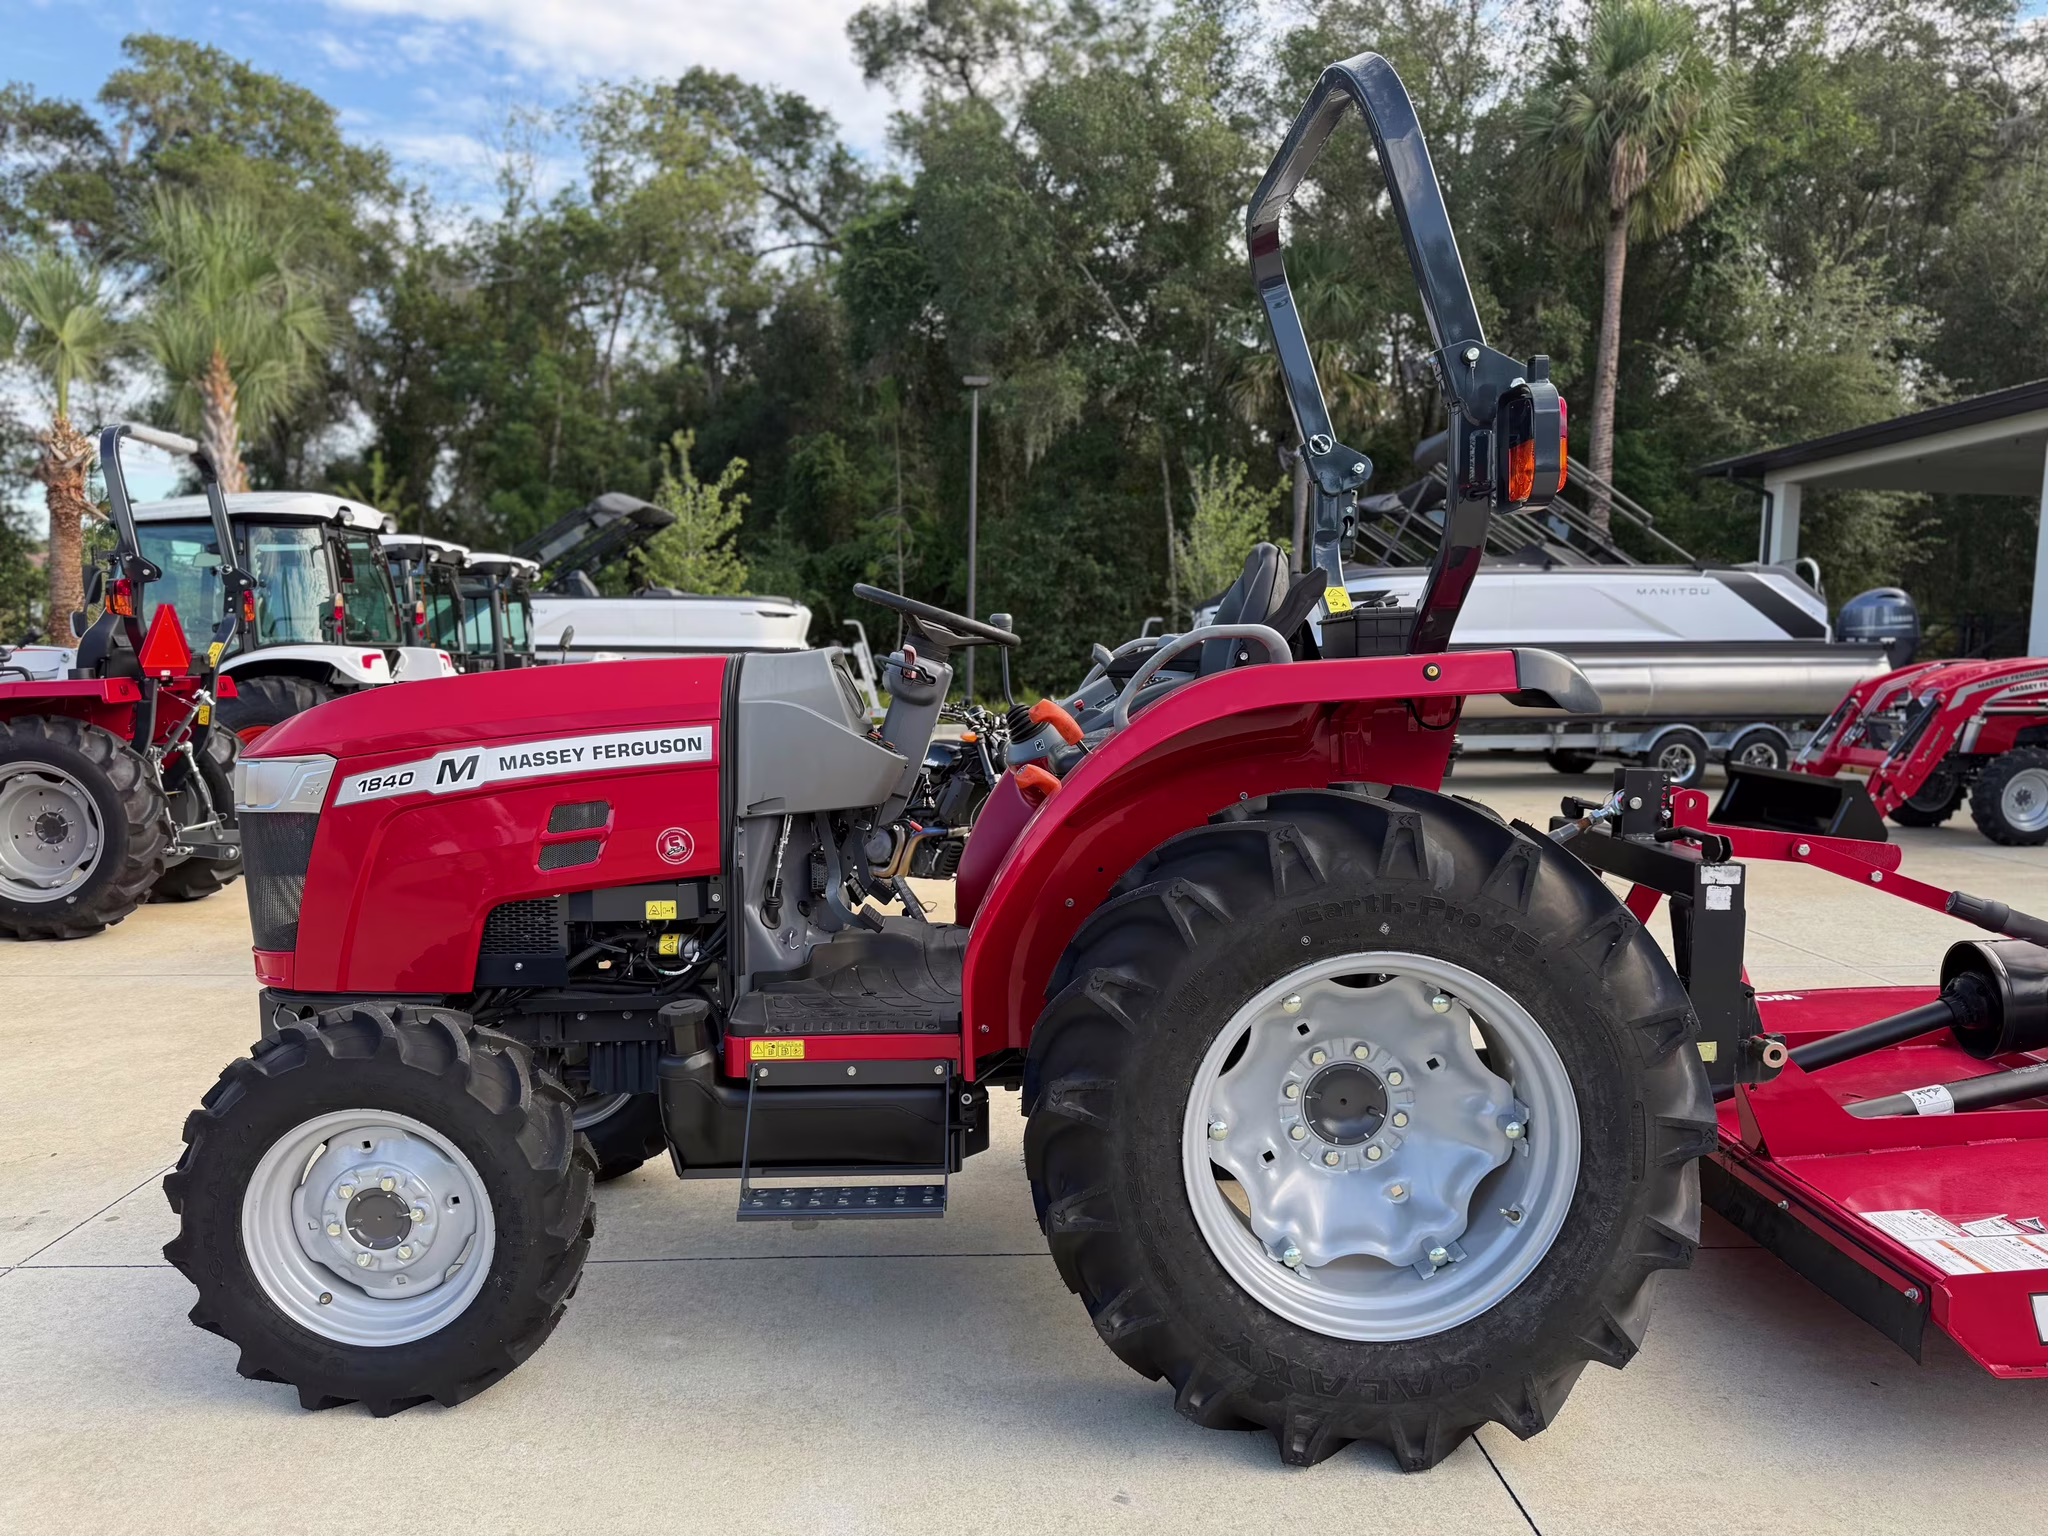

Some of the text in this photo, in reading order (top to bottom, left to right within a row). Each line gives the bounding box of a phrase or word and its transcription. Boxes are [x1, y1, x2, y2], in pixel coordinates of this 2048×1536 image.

[1636, 587, 1711, 596] MANITOU
[2008, 682, 2038, 693] MASSEY
[357, 736, 703, 793] 1840 M MASSEY FERGUSON
[1296, 893, 1541, 959] Earth-Pro 45
[1220, 1332, 1482, 1405] GALAXY
